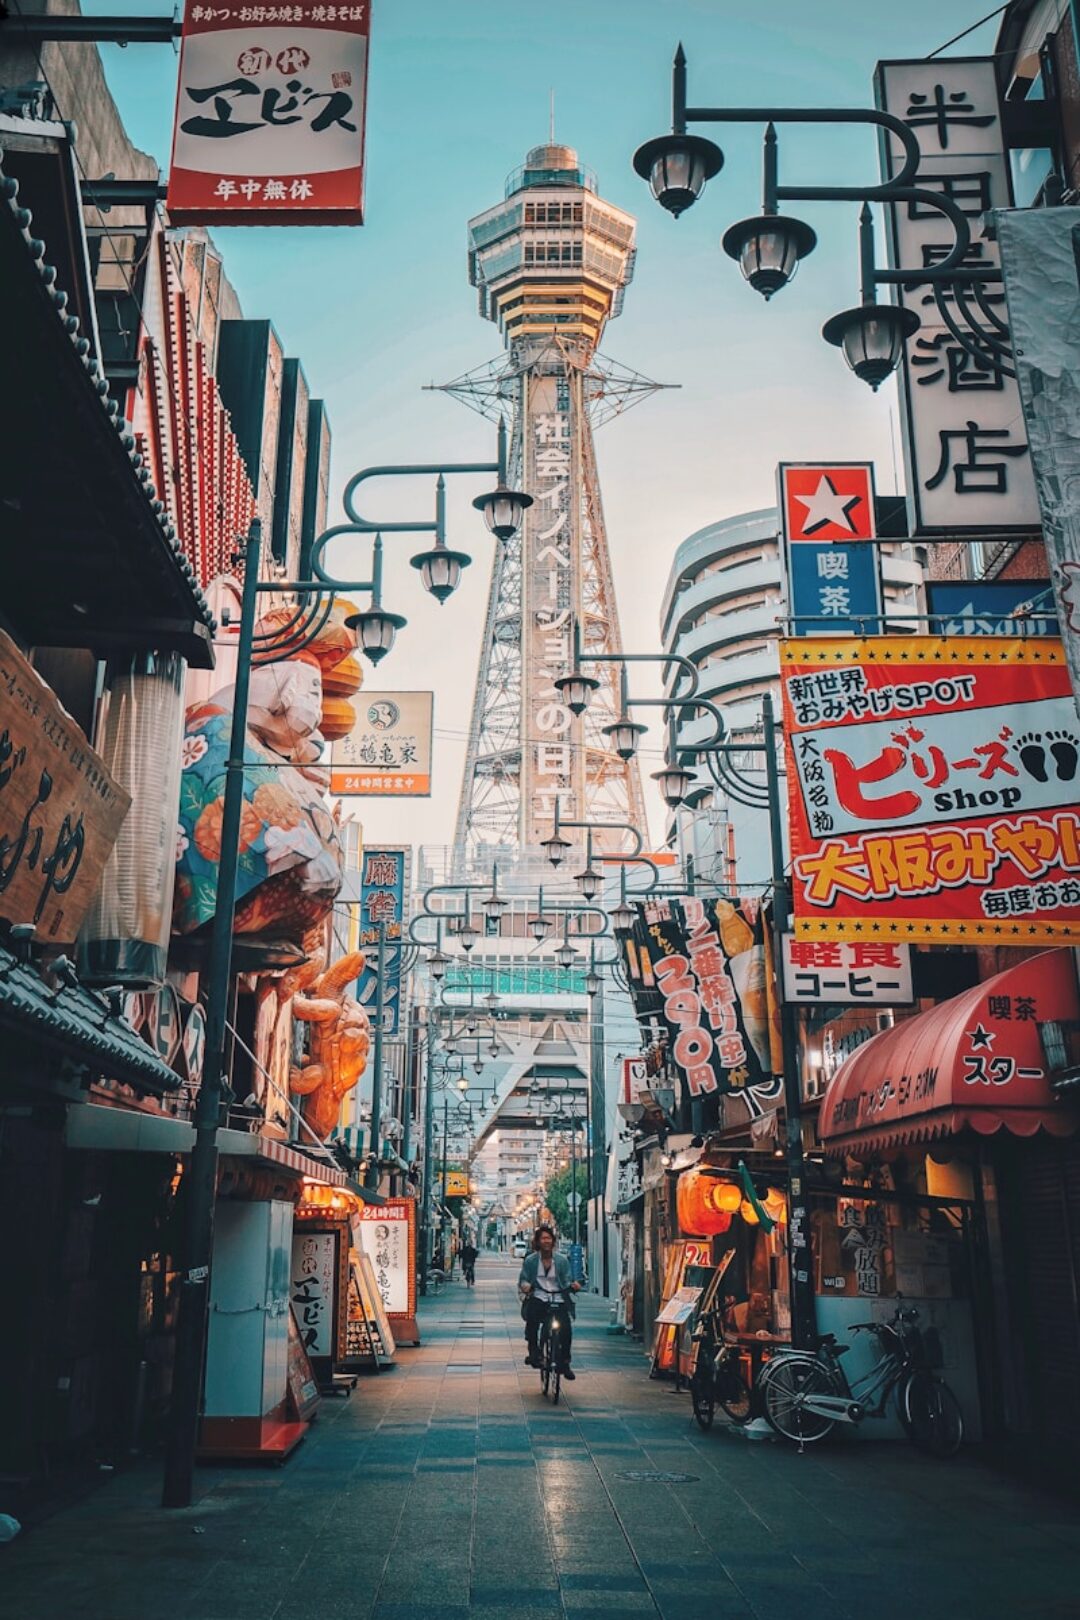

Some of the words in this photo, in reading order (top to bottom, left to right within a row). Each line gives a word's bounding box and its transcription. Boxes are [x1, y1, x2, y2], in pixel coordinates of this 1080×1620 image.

[191, 4, 365, 22] 串かつ・お好み焼き・焼きそば
[213, 179, 314, 202] 年中無休
[816, 551, 851, 616] 喫茶
[787, 667, 867, 703] 新世界
[797, 676, 976, 726] おみやげSPOT
[798, 736, 834, 833] 大阪名物
[823, 720, 1021, 820] ビリーズ
[933, 785, 1022, 813] Shop
[364, 853, 398, 924] 麻雀
[789, 939, 902, 969] 軽食
[795, 972, 901, 998] コーヒー
[988, 996, 1037, 1021] 喫茶
[963, 1055, 1044, 1086] スター
